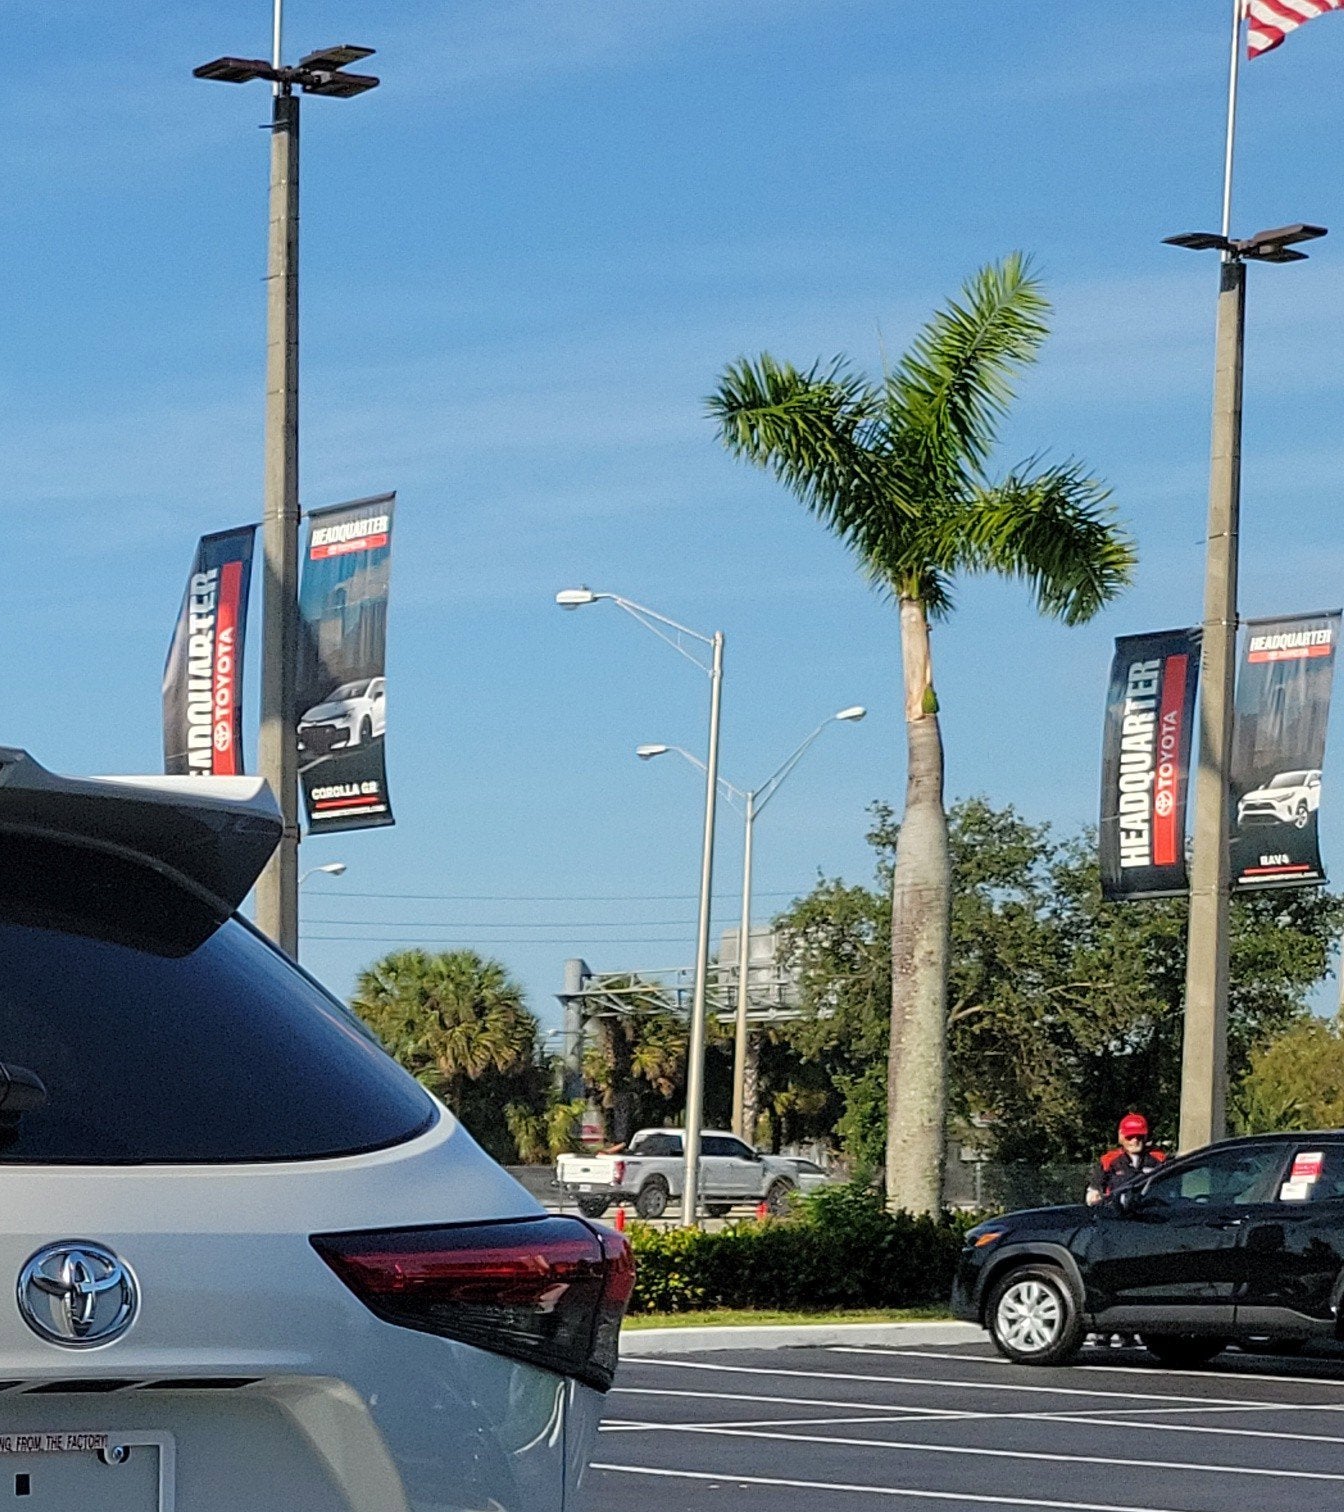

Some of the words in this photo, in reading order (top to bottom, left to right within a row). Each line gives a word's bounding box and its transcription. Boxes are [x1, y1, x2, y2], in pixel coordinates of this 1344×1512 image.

[187, 568, 218, 776] ADQUARTER
[215, 627, 235, 721] TOYOTA
[311, 783, 360, 800] COROLLA
[1119, 657, 1160, 868] HEADQUARTER
[1158, 710, 1178, 789] TOYOTA
[45, 1434, 63, 1450] THE
